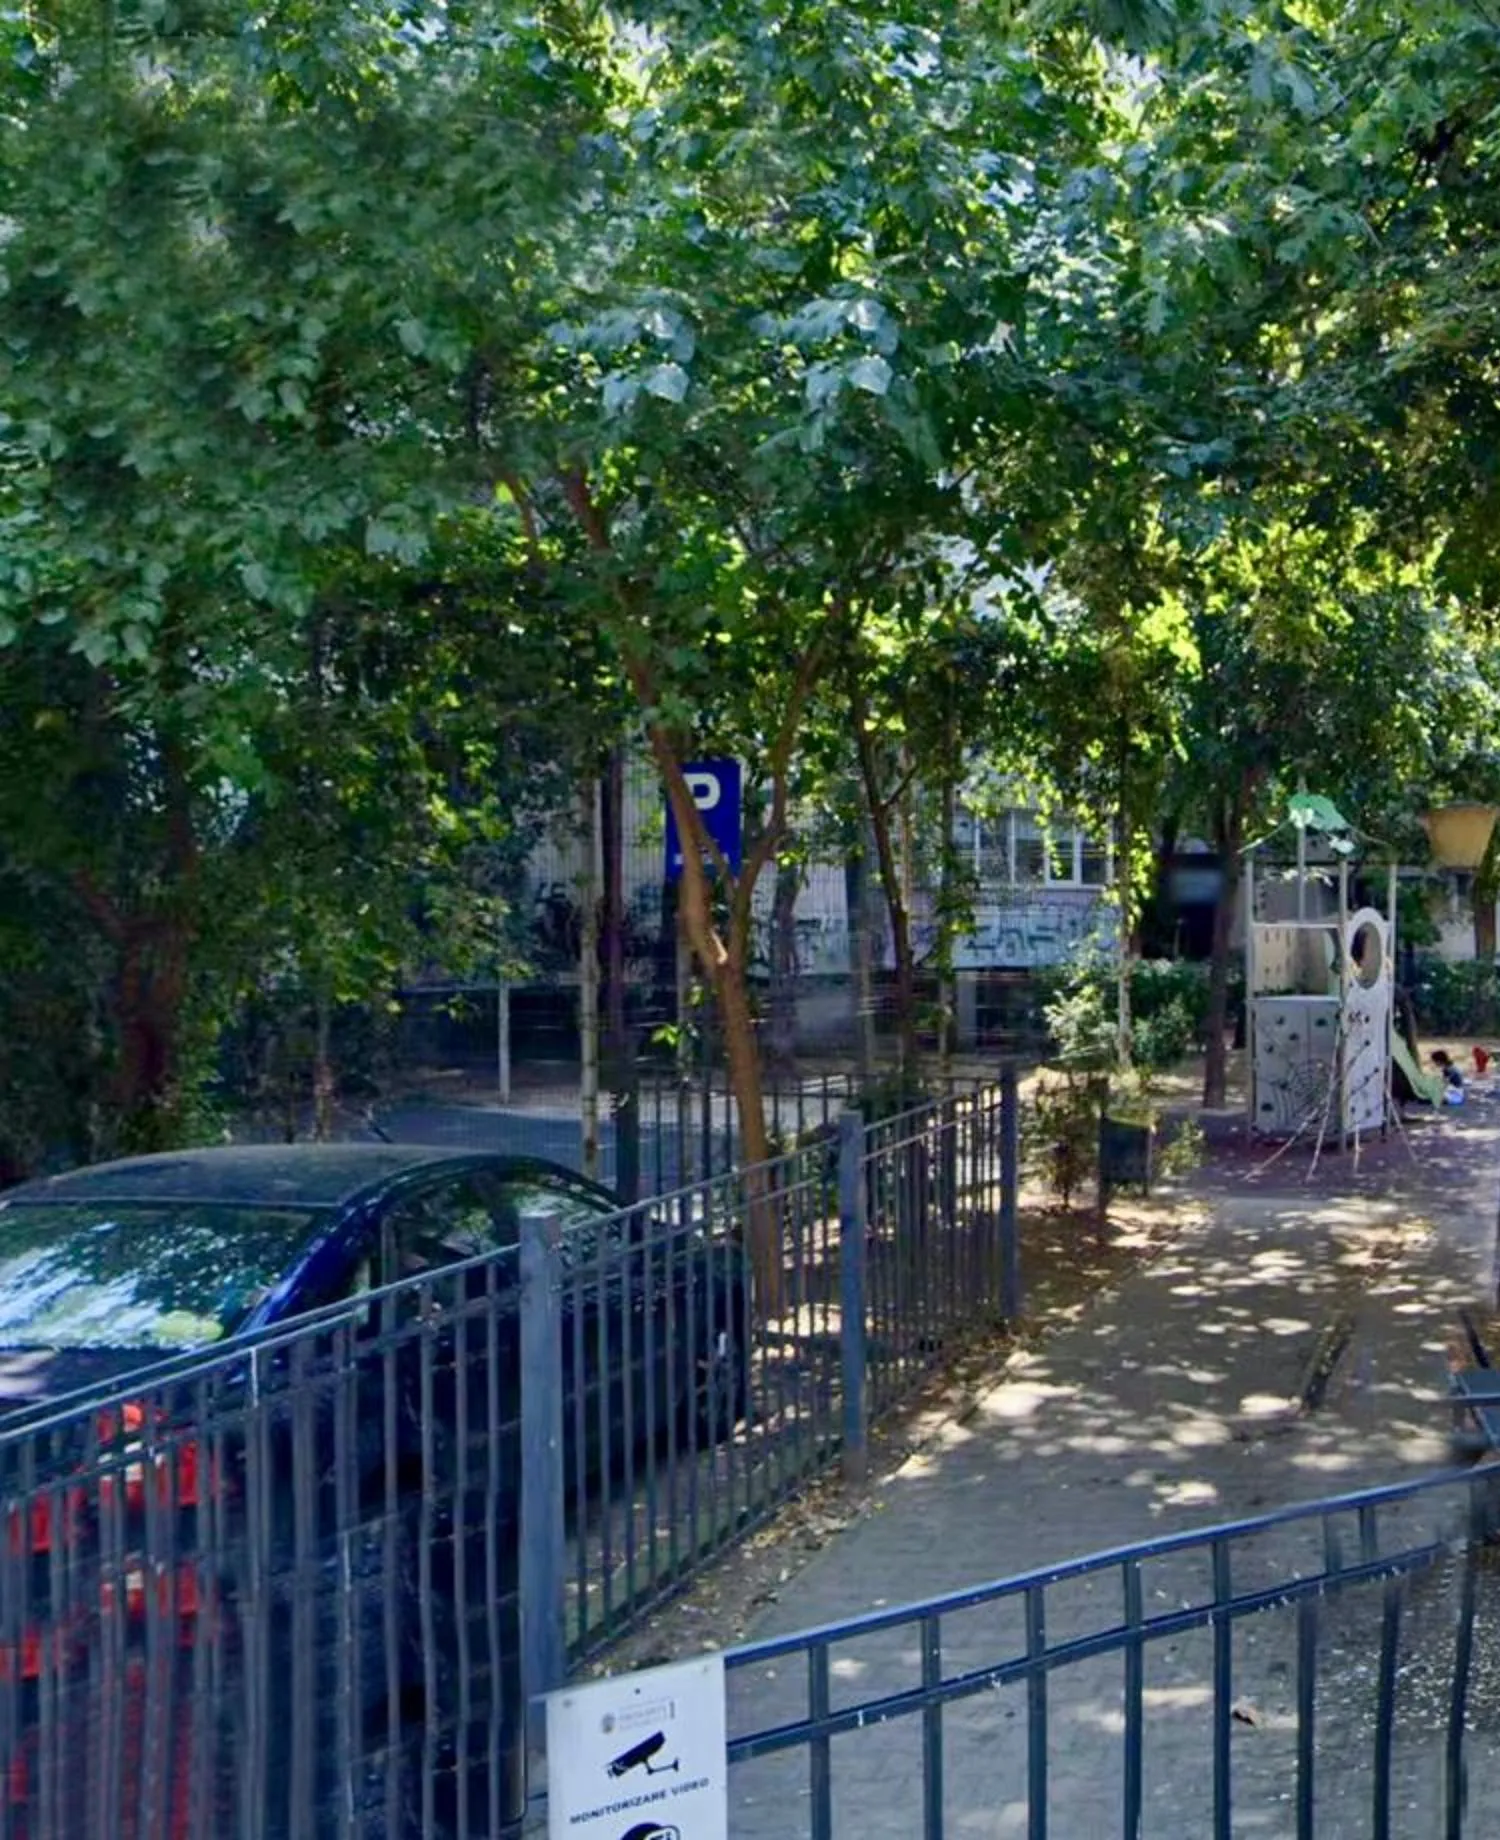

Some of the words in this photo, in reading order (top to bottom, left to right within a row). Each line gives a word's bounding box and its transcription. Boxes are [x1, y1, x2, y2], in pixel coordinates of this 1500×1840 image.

[682, 772, 720, 810] P
[570, 1790, 666, 1824] MONITORIZARE
[671, 1777, 709, 1796] VIDEO
